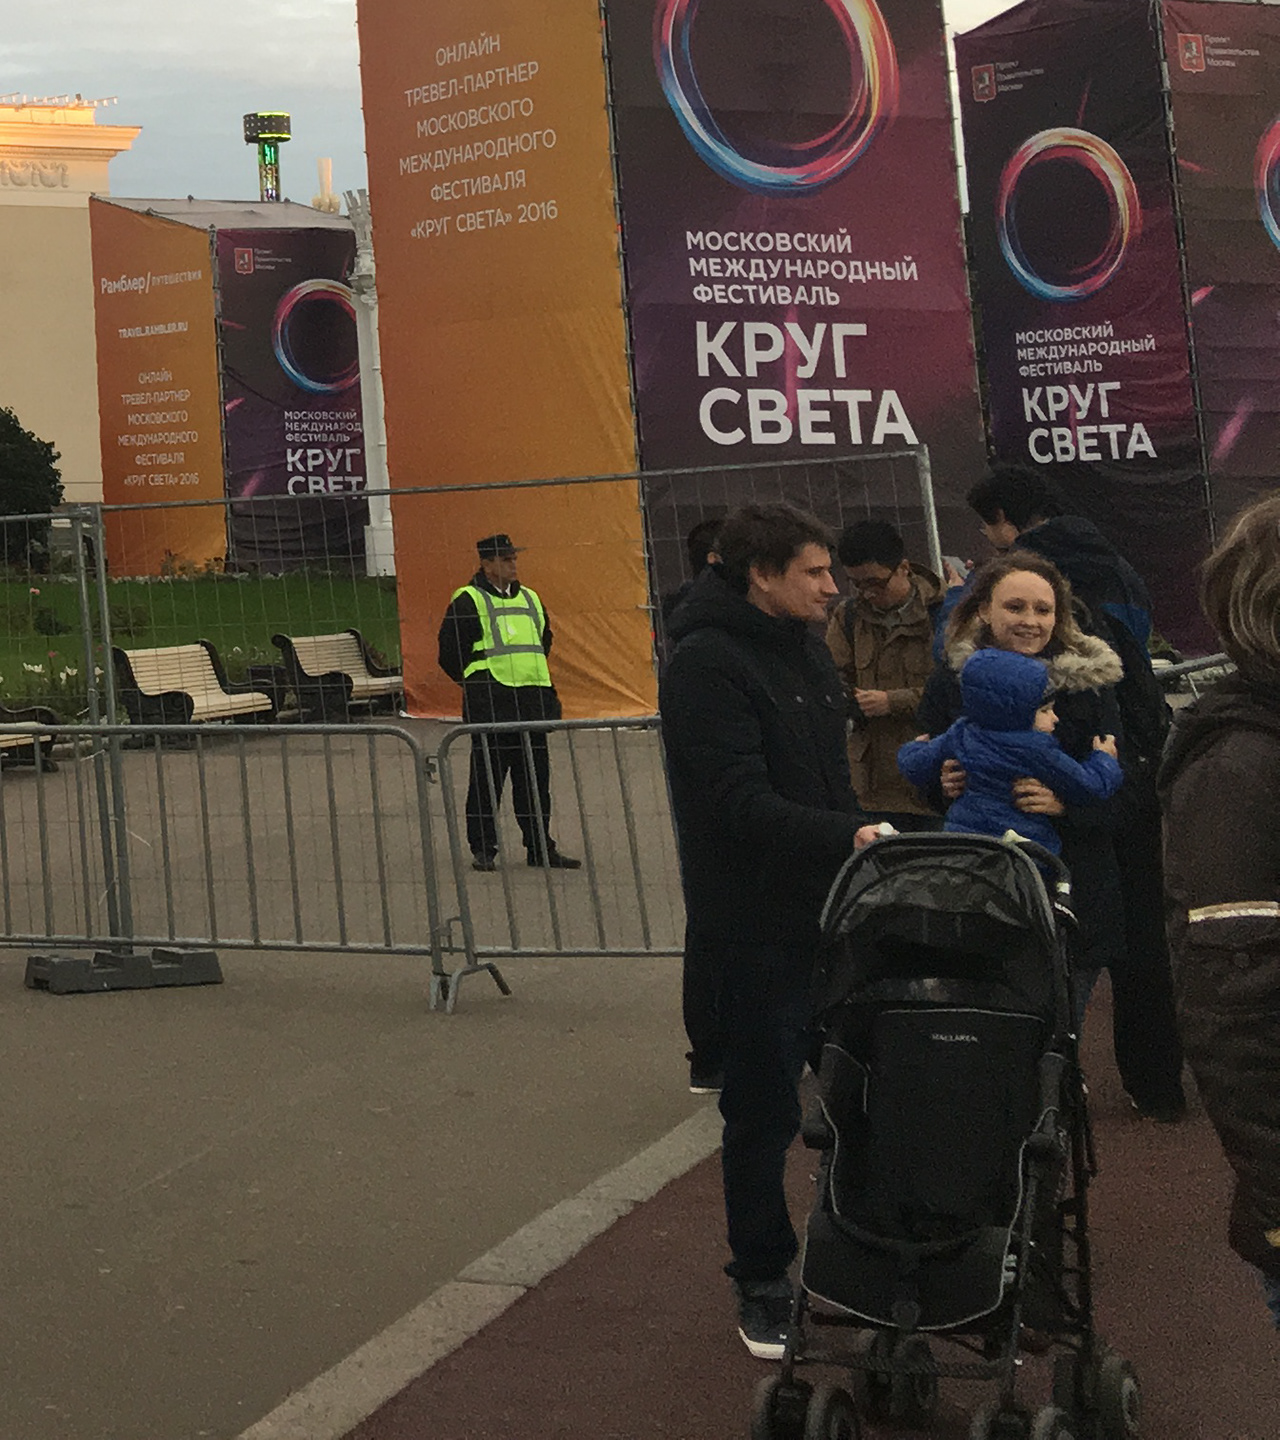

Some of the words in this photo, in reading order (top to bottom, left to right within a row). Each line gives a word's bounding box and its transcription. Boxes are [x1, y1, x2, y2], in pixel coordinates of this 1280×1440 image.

[435, 31, 501, 67] ОНЛАЙН
[404, 61, 539, 107] ТРЕВЕЛ-ПАРТНЕР
[416, 97, 534, 139] МОСКОВСКОГО
[398, 128, 557, 176] МЕЖДУНАРОДНОГО
[430, 168, 527, 203] ФЕСТИВАЛЯ
[410, 216, 452, 239] «КРУГ
[456, 208, 513, 233] СВЕТА»
[517, 199, 559, 224] 2016
[685, 227, 853, 253] МОСКОВСКИЙ
[688, 255, 919, 283] МЕЖДУНАРОДНЫЙ
[692, 283, 840, 306] ФЕСТИВАЛЬ
[1015, 320, 1114, 345] МОСКОВСКИЙ
[695, 320, 868, 379] КРУГ
[1017, 334, 1156, 361] МЕЖДУНАРОДНЫЙ
[138, 367, 173, 385] ОНЛАЙН
[1018, 359, 1103, 378] ФЕСТИВАЛЬ
[284, 408, 358, 420] МОСКОВСКИЙ
[1021, 381, 1121, 423] КРУГ
[127, 410, 189, 426] МОСКОВСКОГО
[698, 386, 920, 446] СВЕТА
[118, 430, 199, 447] МЕЖДУНАРОДНОГО
[285, 433, 351, 443] ФЕСТИВАЛЬ
[1028, 422, 1158, 464] СВЕТА
[135, 451, 186, 466] ФЕСТИВАЛЯ
[286, 448, 361, 472] КРУГ
[287, 475, 368, 500] СВЕТ
